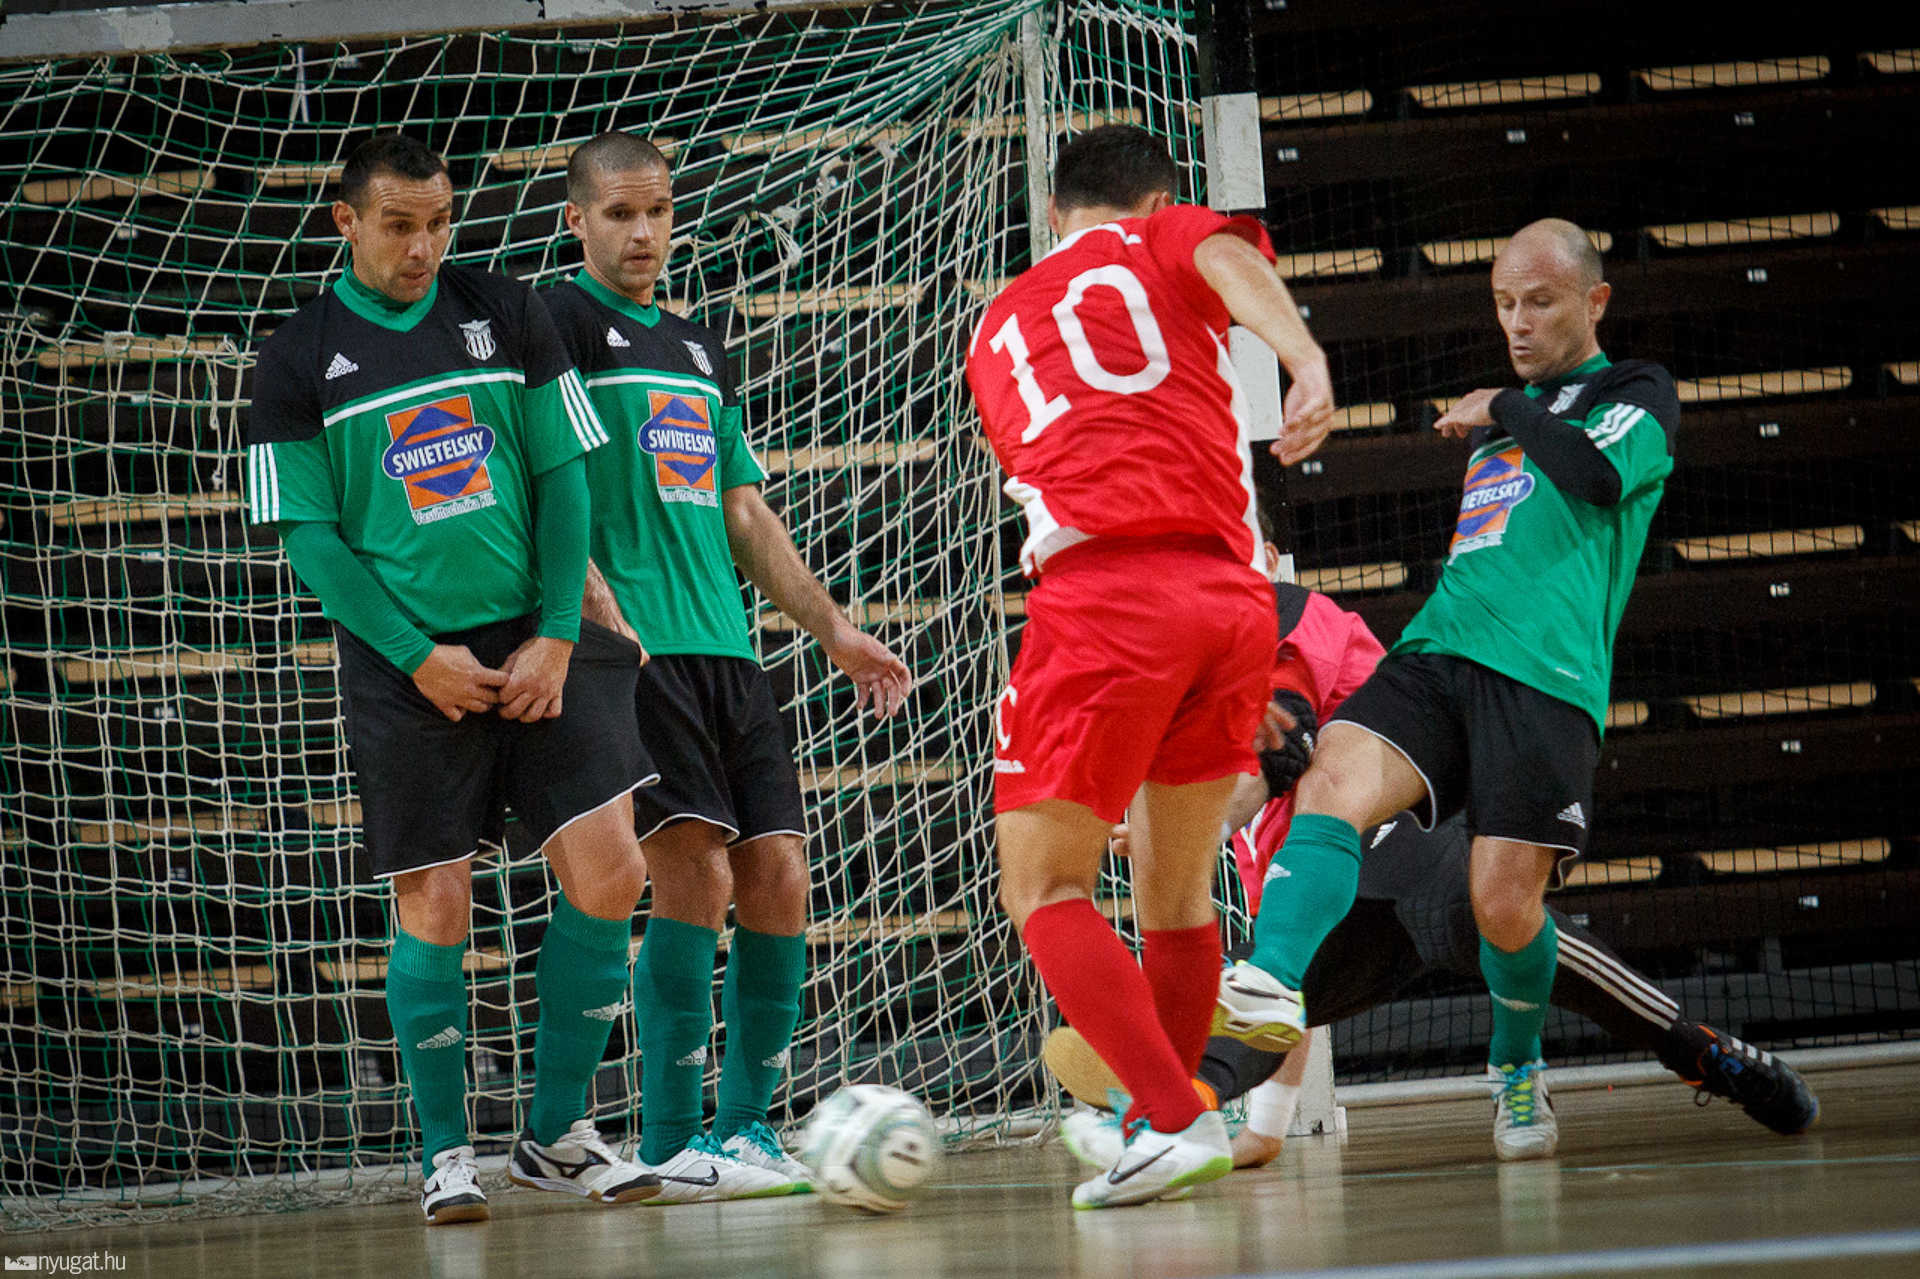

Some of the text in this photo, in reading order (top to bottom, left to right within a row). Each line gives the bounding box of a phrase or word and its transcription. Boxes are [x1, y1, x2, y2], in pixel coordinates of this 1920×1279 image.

[988, 263, 1172, 444] 10
[392, 431, 484, 474] SWIETELSKY
[648, 429, 716, 455] SWIETELSKY
